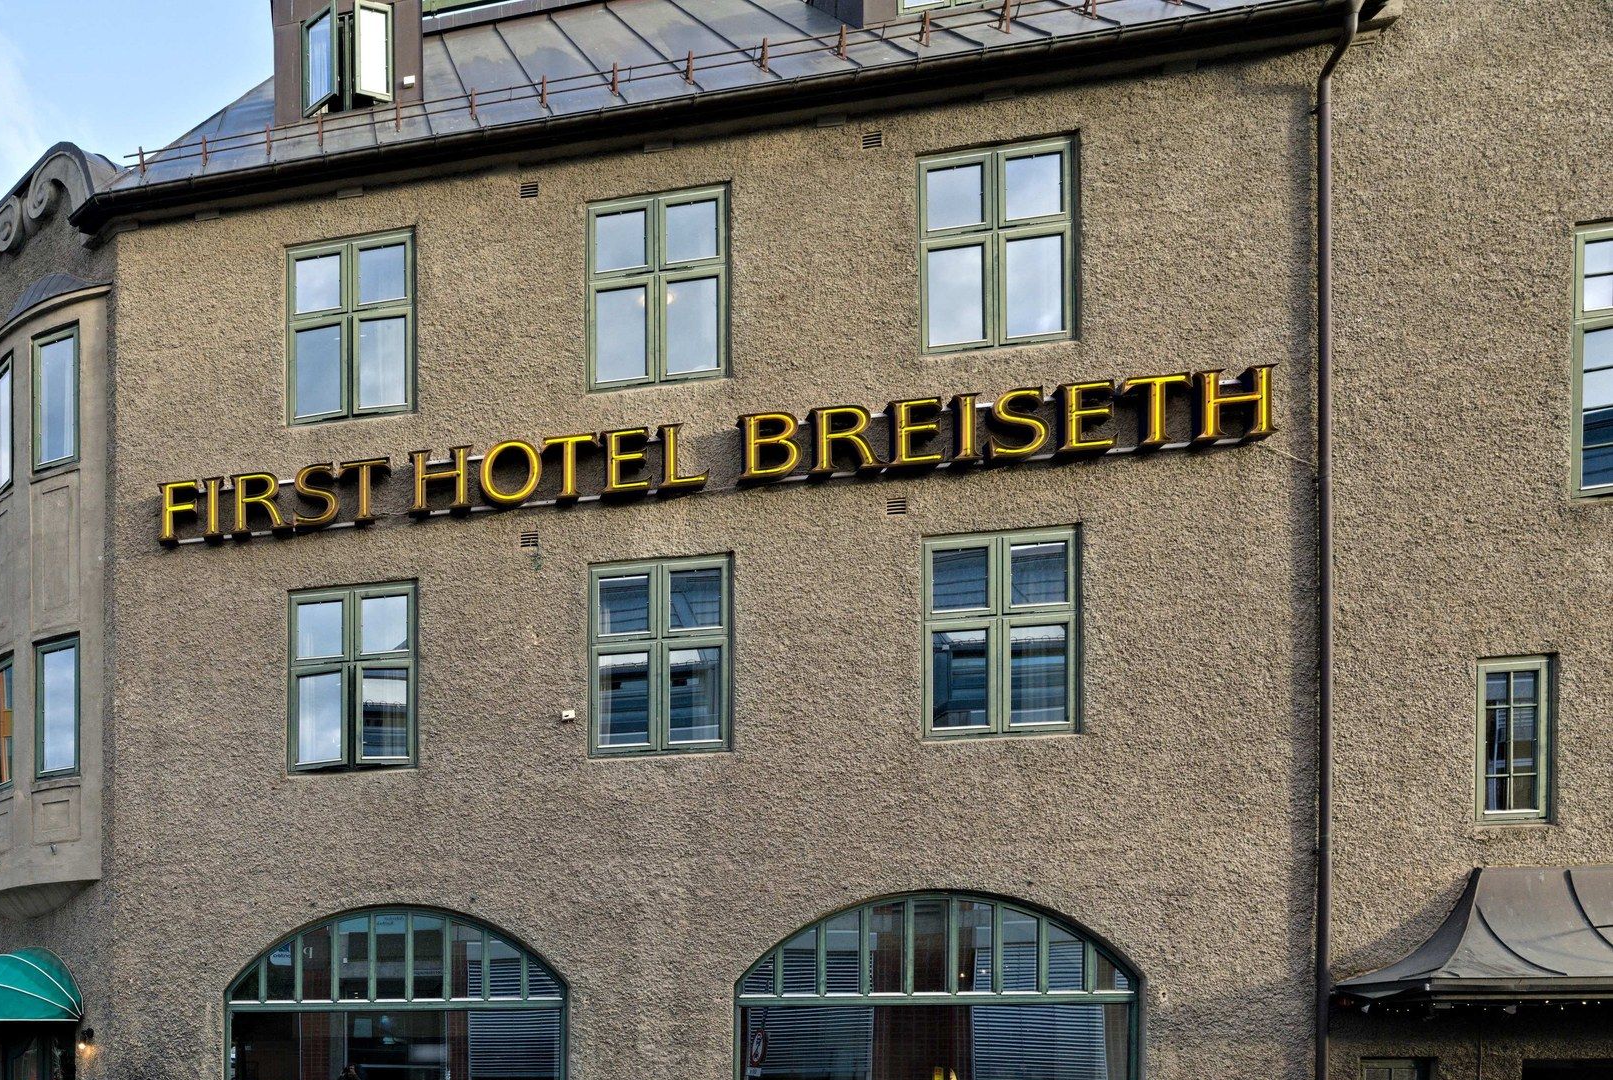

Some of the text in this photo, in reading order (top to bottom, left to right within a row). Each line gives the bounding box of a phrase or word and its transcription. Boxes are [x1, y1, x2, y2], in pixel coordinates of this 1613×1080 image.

[157, 362, 1278, 546] FIRST HOTEL BREISETH
